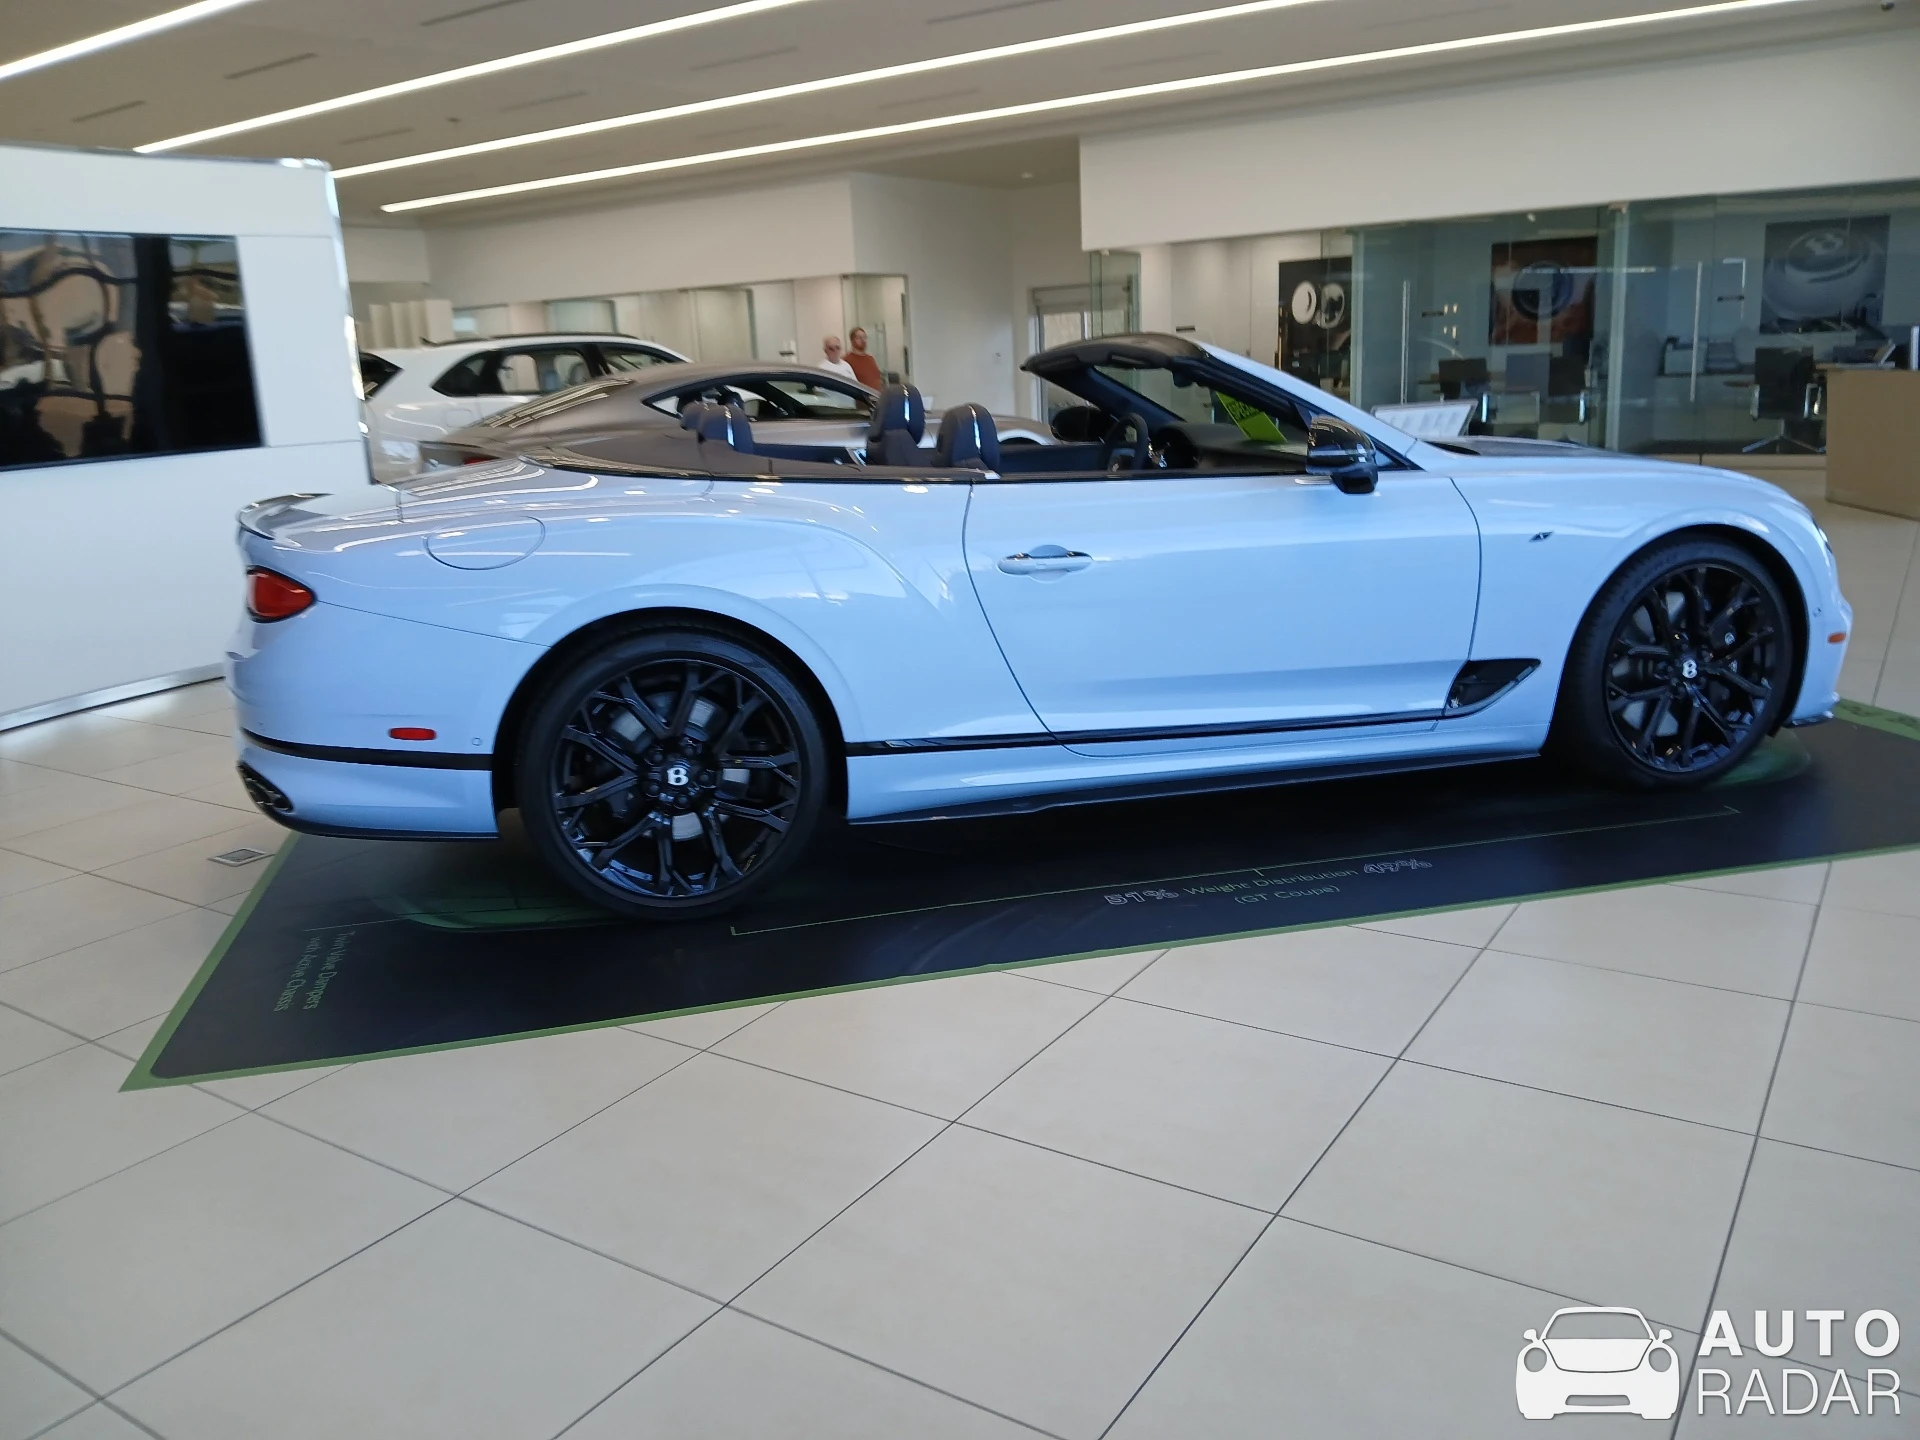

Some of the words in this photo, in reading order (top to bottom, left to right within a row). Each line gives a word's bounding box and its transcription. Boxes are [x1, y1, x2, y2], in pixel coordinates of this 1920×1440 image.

[1682, 660, 1697, 678] B
[666, 767, 689, 786] B
[1104, 889, 1179, 905] 51%
[1183, 882, 1251, 896] Weight
[1253, 869, 1359, 887] Distribution
[1234, 893, 1269, 904] (GT
[1274, 885, 1341, 899] Coupe)
[273, 979, 307, 1012] Chassis
[302, 971, 338, 1010] Dampers
